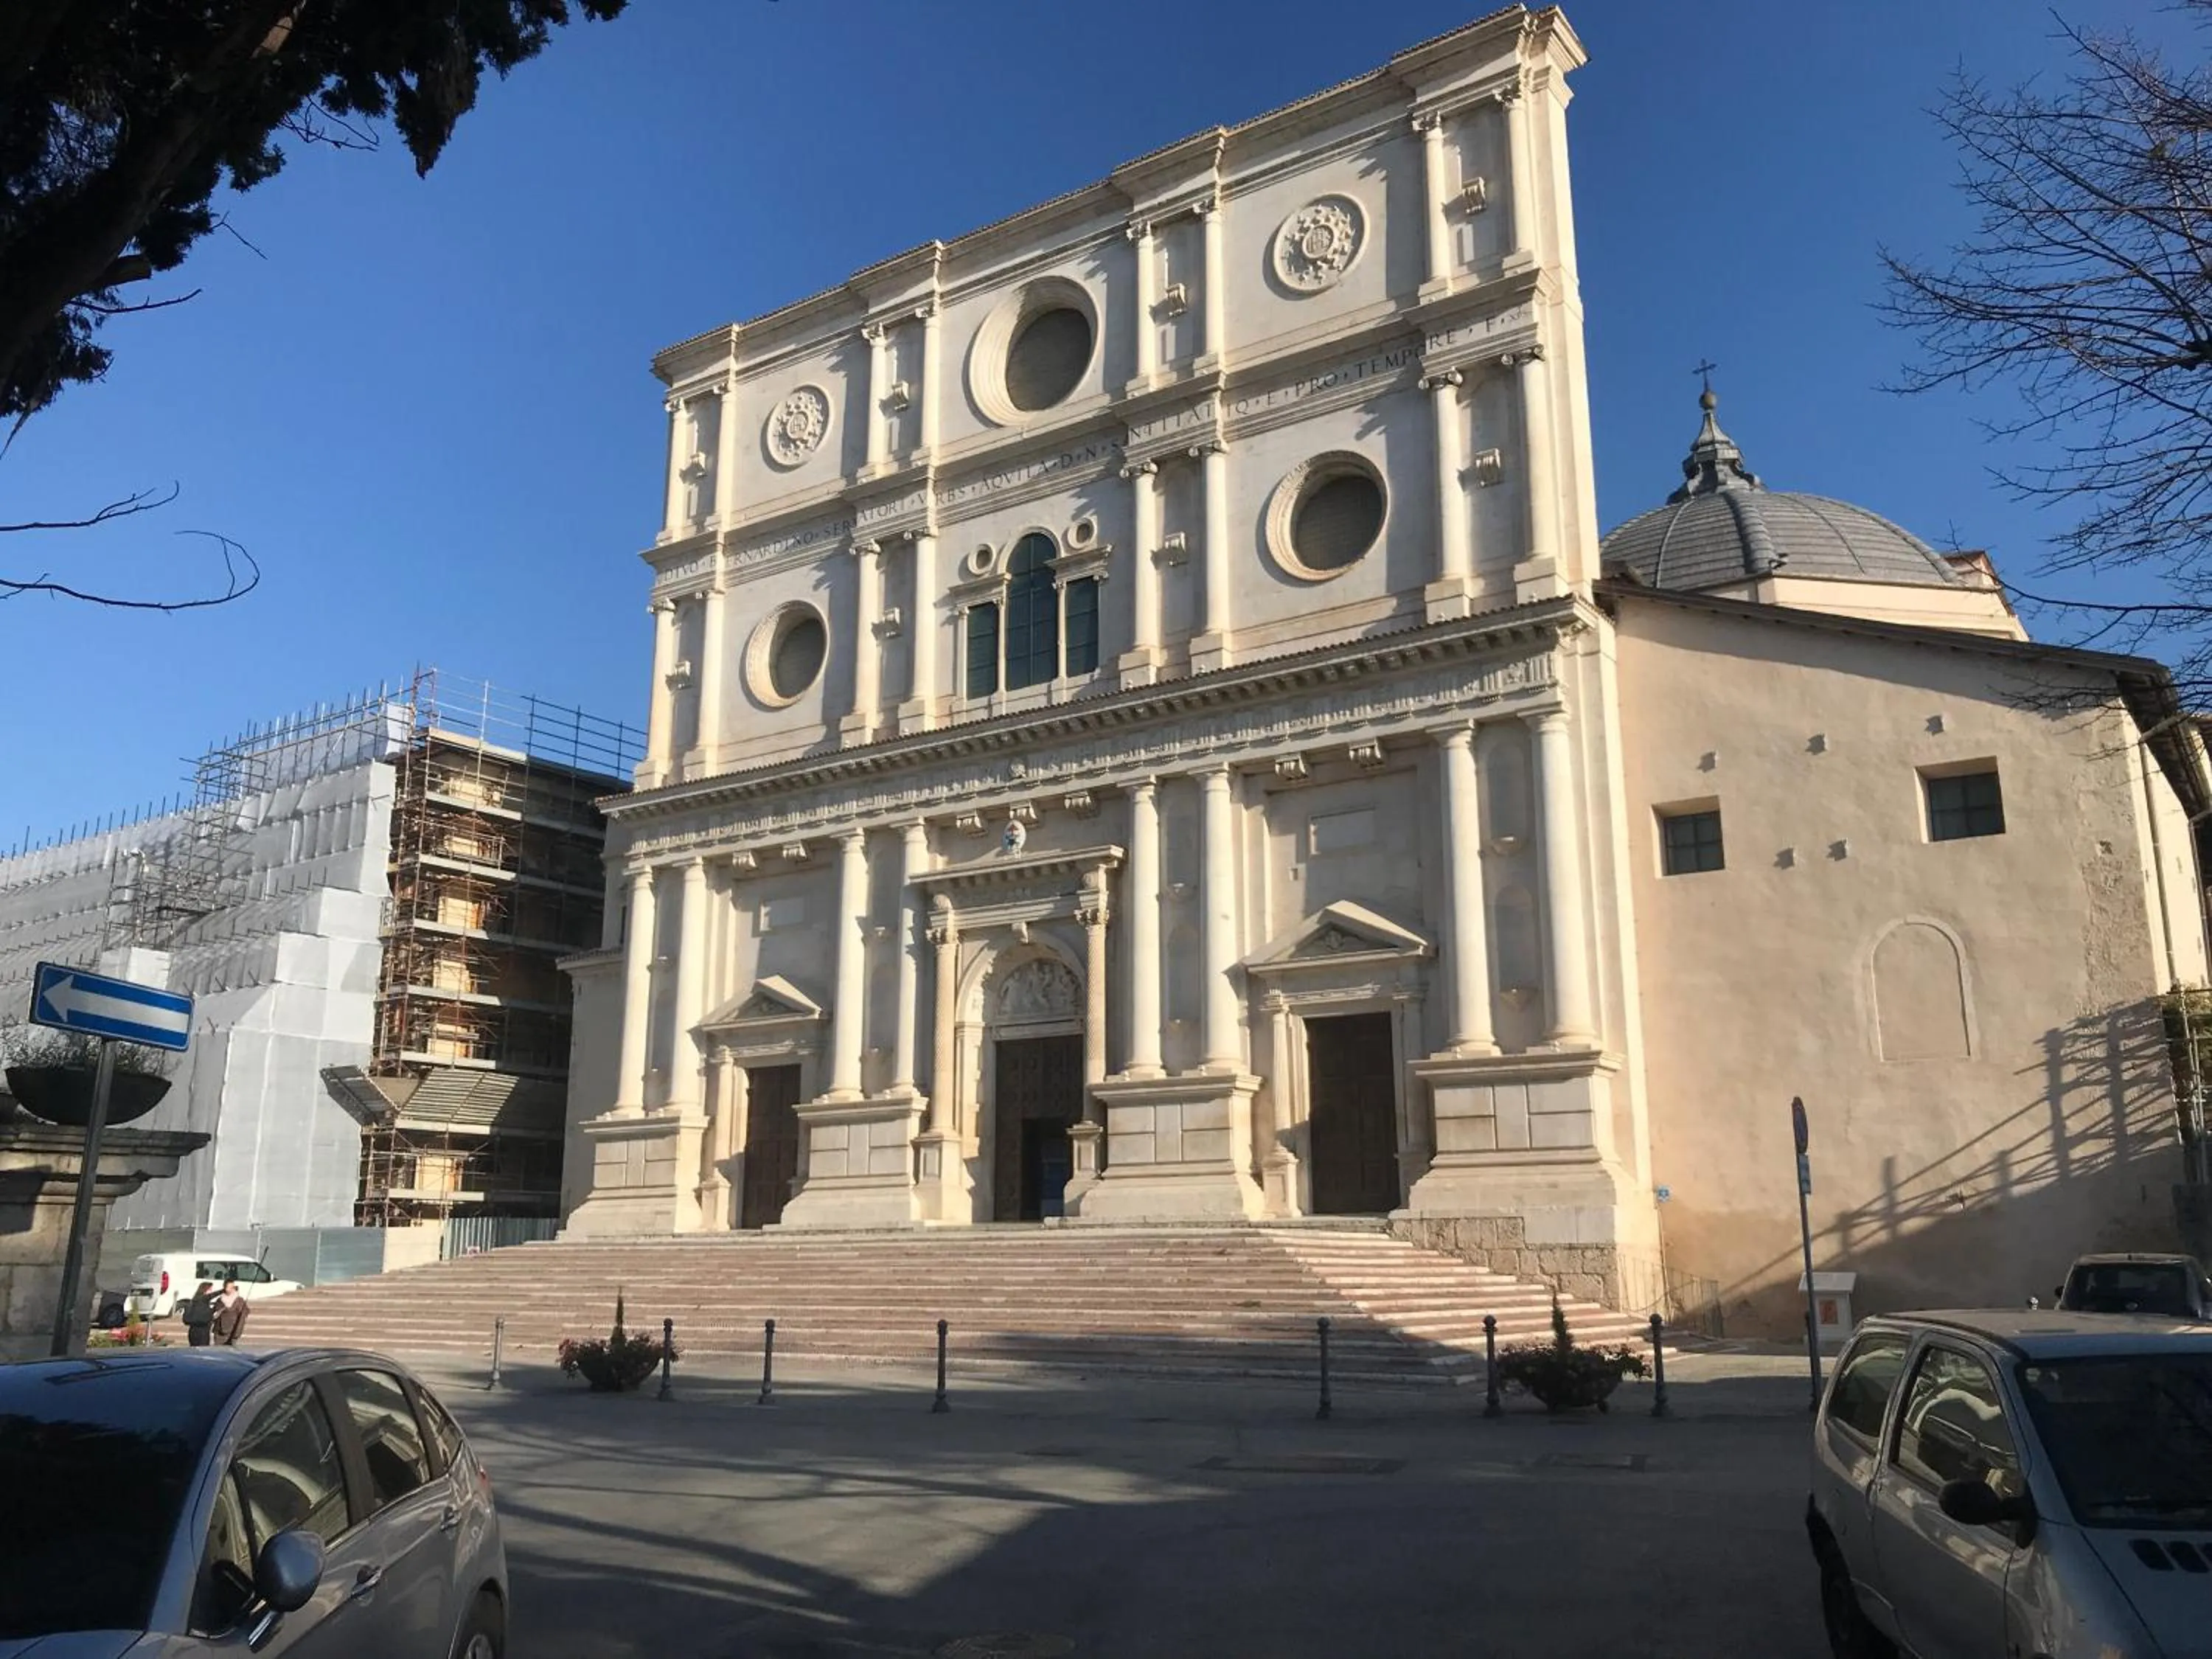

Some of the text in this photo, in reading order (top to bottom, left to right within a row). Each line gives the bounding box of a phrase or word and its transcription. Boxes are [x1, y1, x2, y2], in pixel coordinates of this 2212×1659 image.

[1061, 453, 1074, 470] D
[1085, 445, 1097, 461] N
[1295, 372, 1338, 397] PRO
